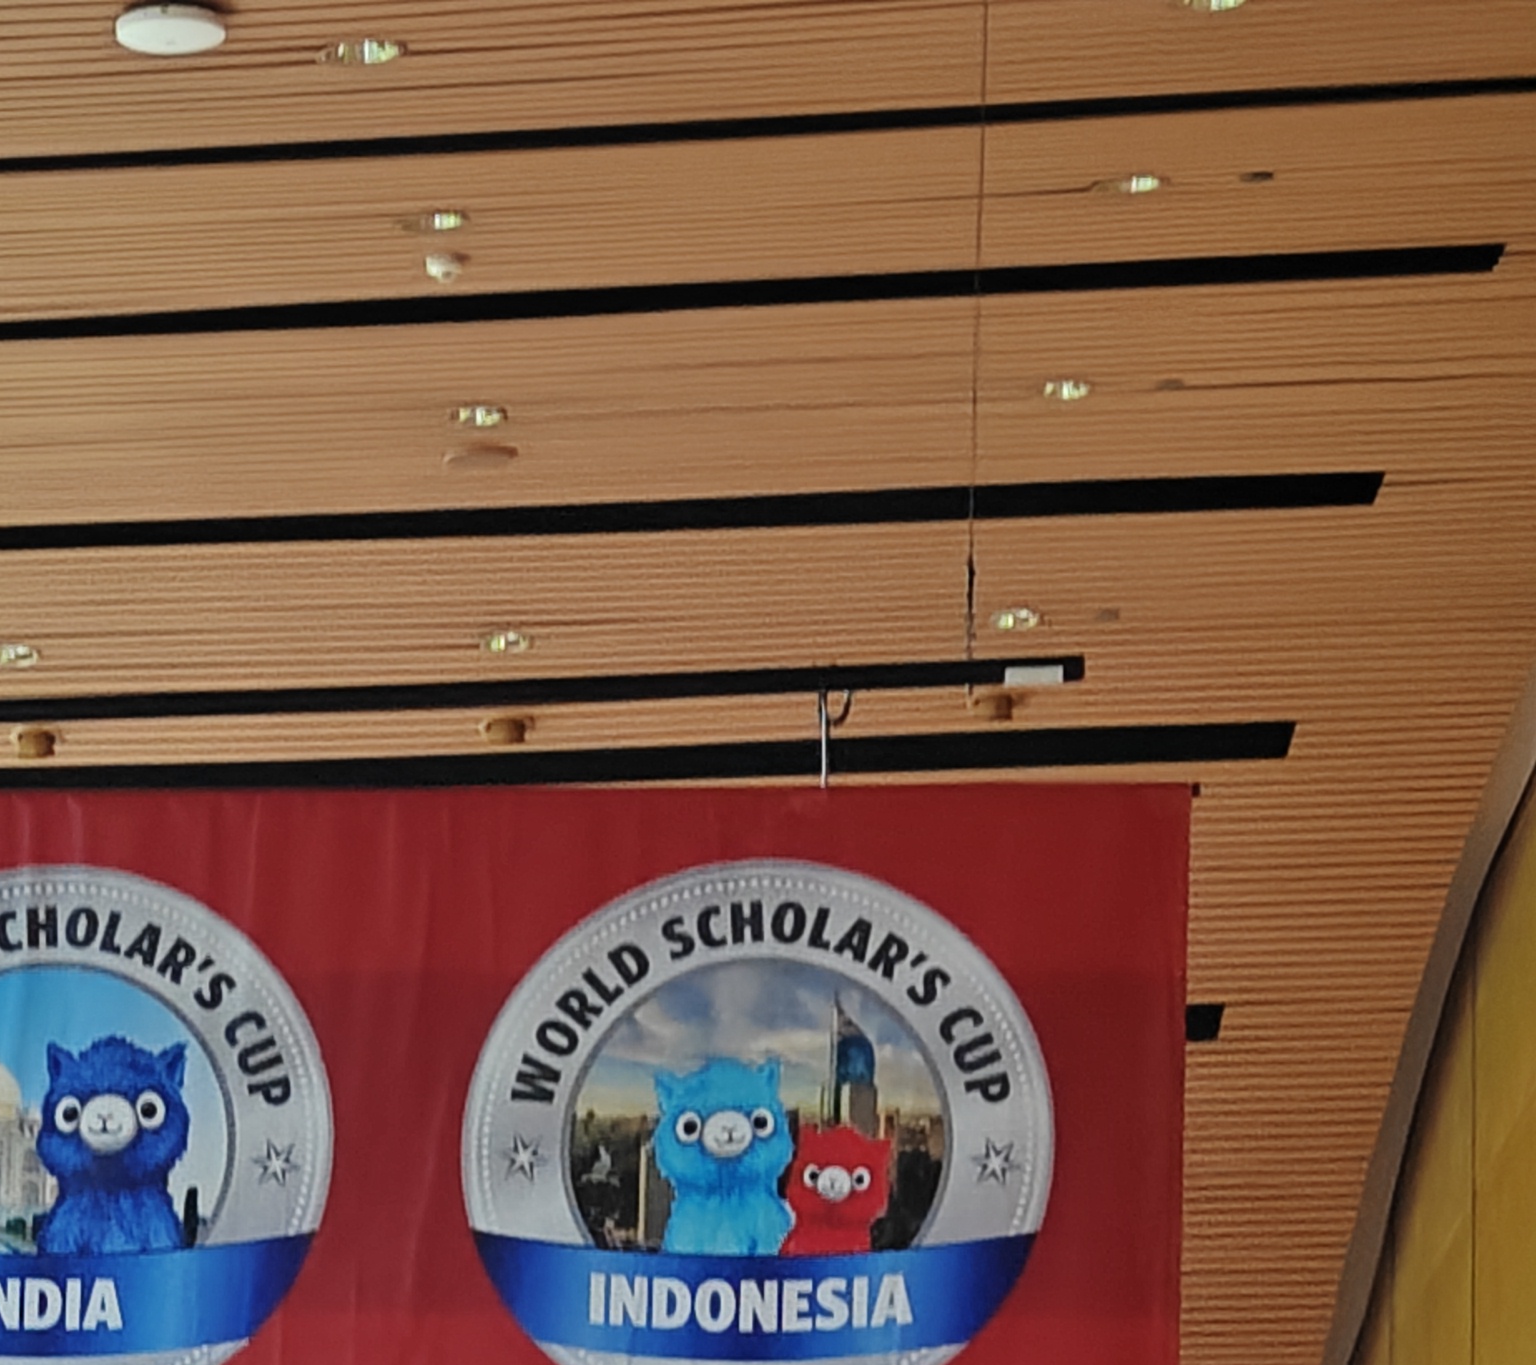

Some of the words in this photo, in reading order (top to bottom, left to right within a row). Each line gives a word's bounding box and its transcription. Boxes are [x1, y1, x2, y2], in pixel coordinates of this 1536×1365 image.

[510, 941, 651, 1105] WORLD
[660, 900, 952, 1008] SCHOLAR'S
[939, 1005, 1011, 1105] CUP
[223, 1010, 292, 1109] CUP
[588, 1271, 914, 1334] INDONESIA
